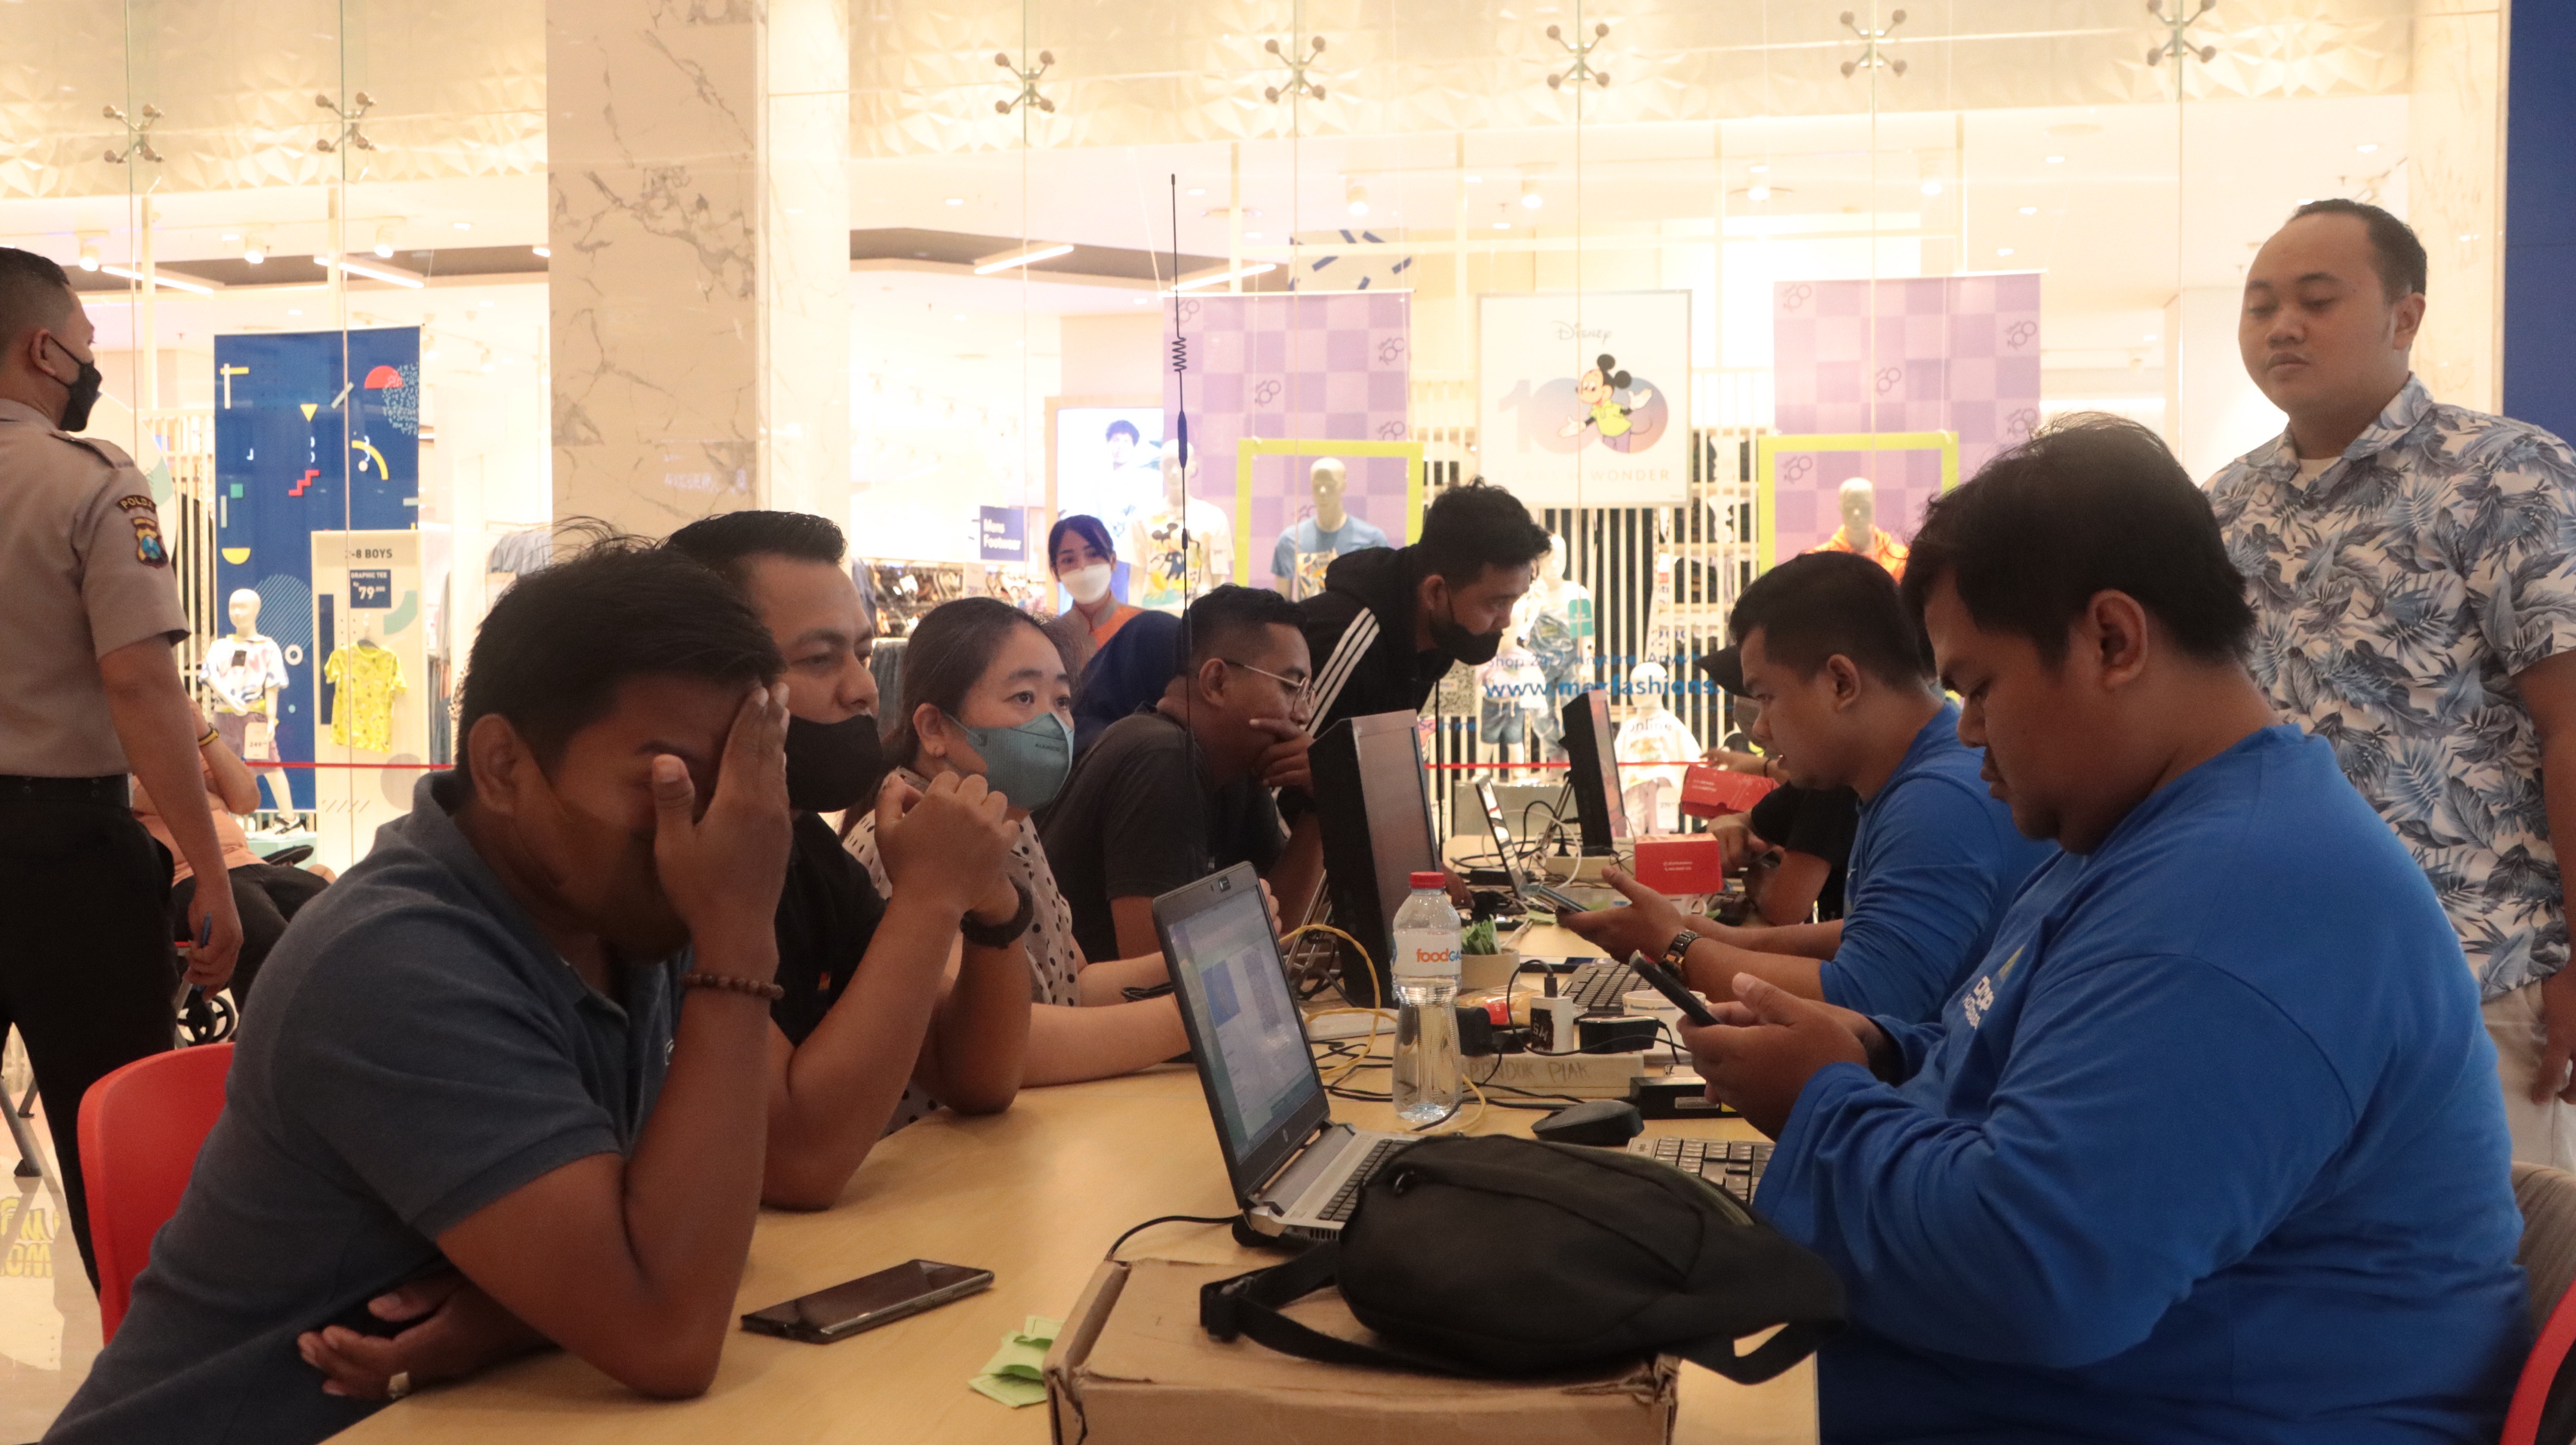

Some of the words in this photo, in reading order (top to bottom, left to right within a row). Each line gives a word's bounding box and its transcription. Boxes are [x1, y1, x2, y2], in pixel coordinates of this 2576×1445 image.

[1590, 469, 1670, 481] WONDER
[983, 533, 1022, 551] Footwear
[365, 548, 393, 558] BOYS
[1484, 673, 1728, 697] www.maxfashions.
[1416, 948, 1462, 963] foodGA
